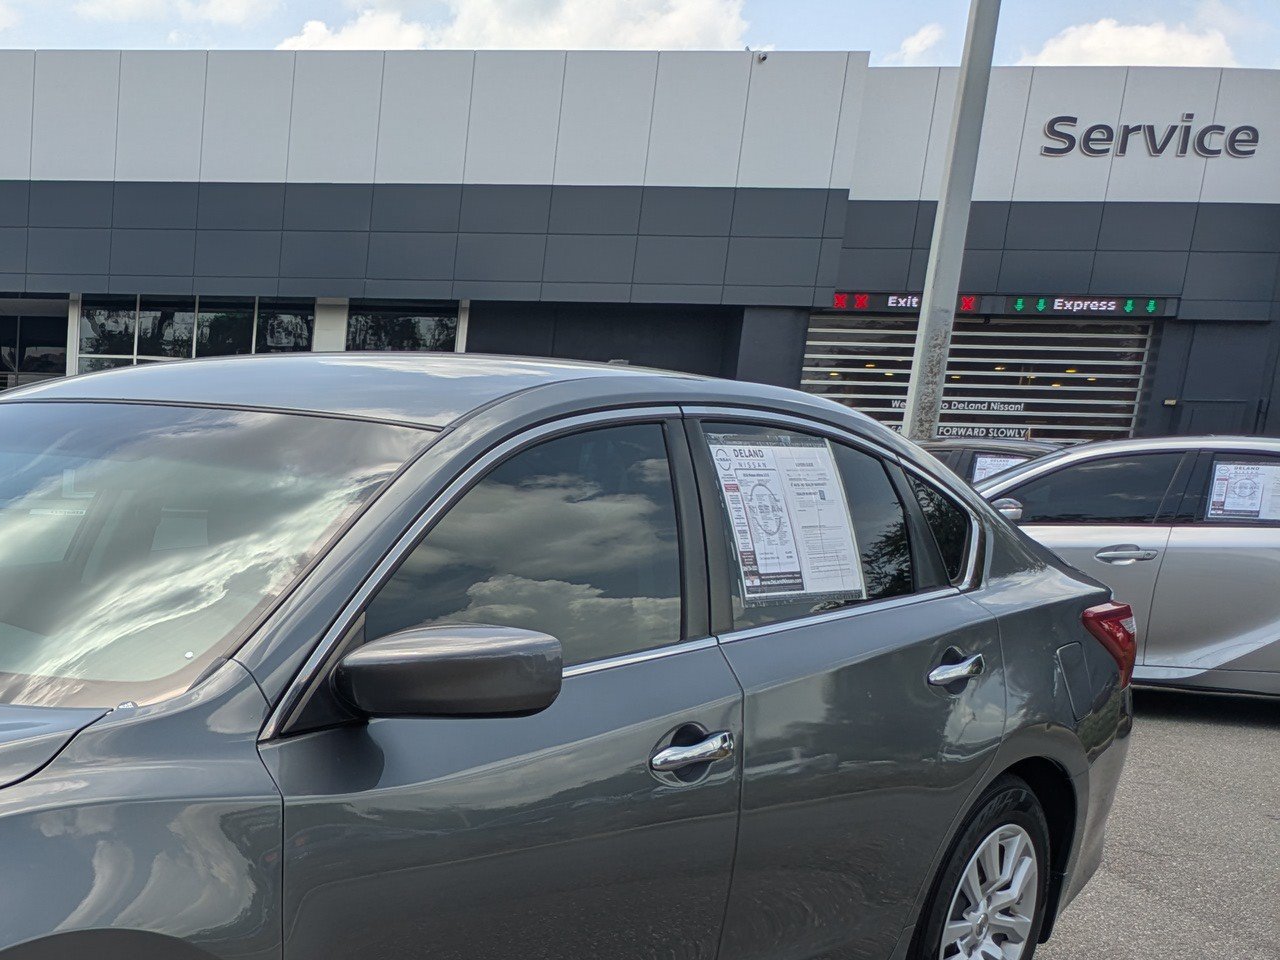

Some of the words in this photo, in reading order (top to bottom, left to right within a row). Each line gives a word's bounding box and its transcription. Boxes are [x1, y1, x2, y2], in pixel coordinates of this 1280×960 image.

[1041, 112, 1260, 157] Service
[888, 295, 919, 307] Exit
[1054, 299, 1116, 311] Express
[951, 401, 988, 410] DeLand
[990, 402, 1025, 411] Nissan!
[938, 427, 987, 436] FORWARD
[988, 428, 1026, 437] SLOWLY
[733, 448, 765, 458] DELAND
